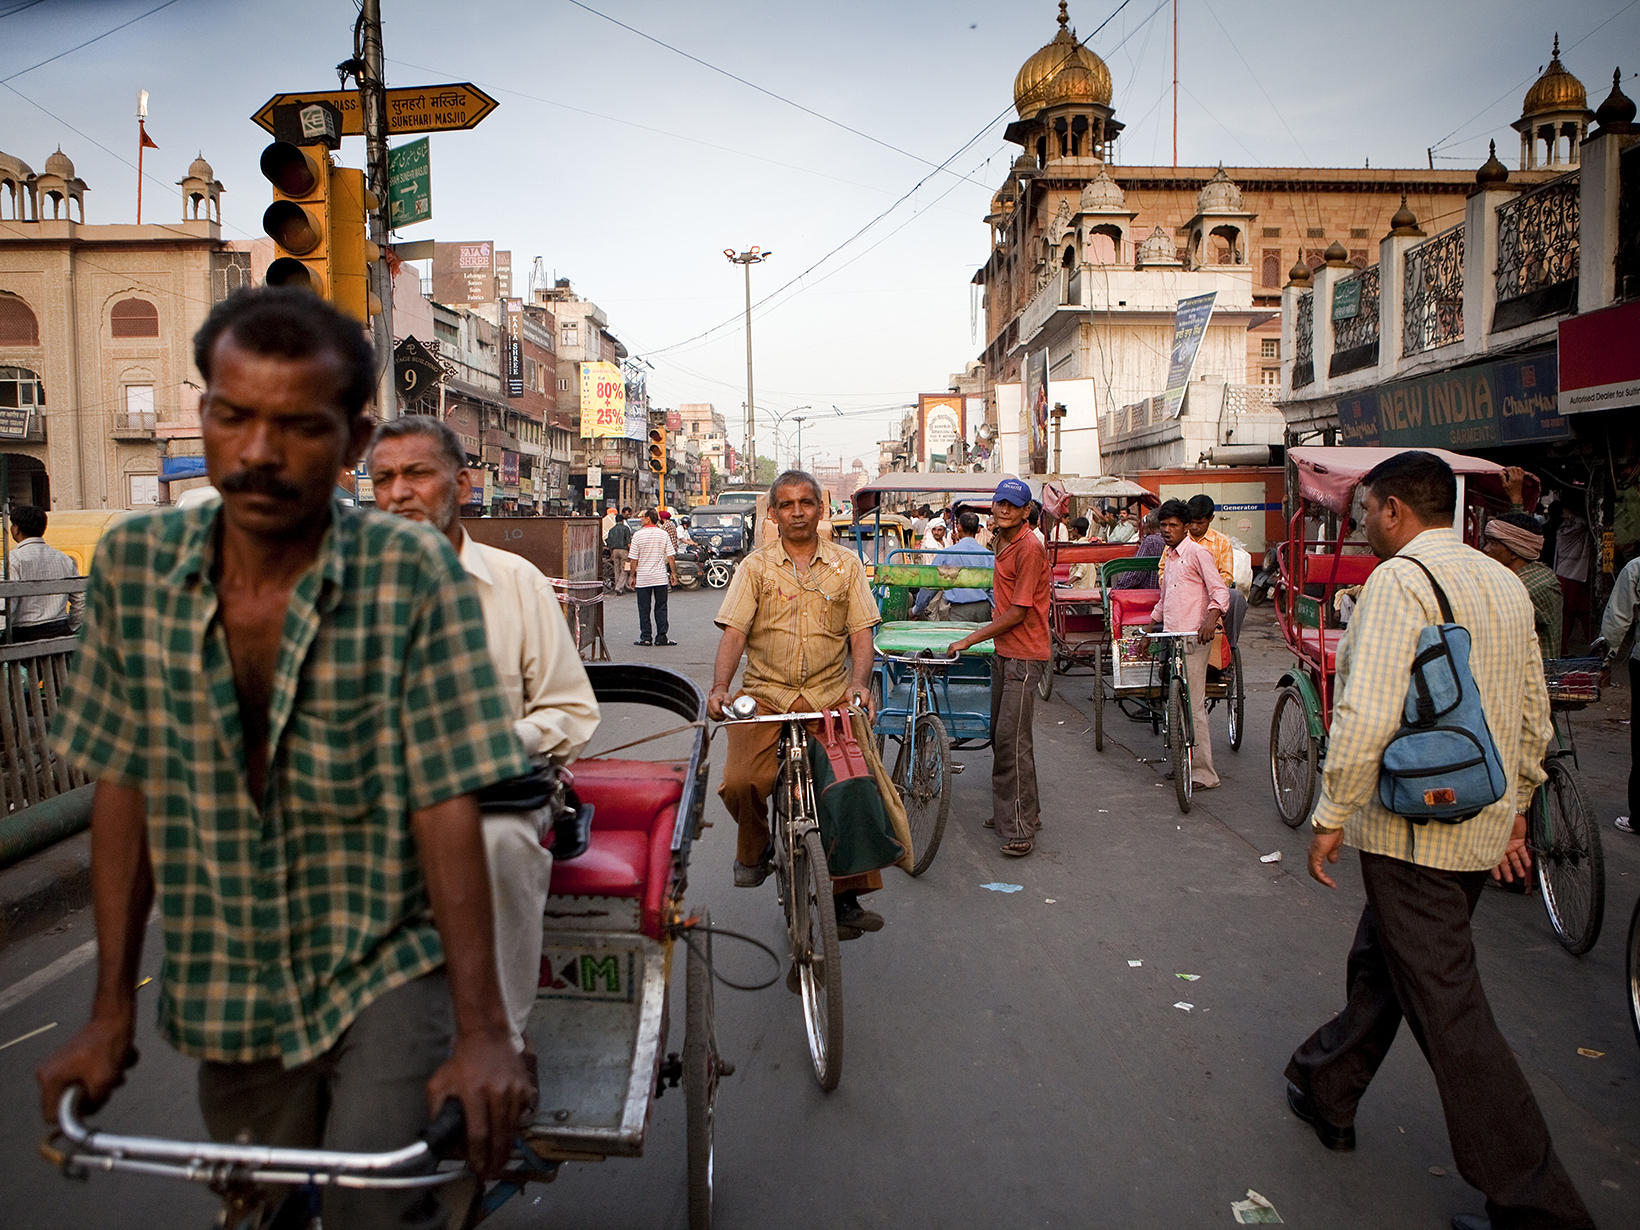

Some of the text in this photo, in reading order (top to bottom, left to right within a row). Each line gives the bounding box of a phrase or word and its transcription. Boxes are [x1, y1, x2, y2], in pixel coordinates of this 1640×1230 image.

[391, 95, 426, 115] सुनहरी
[391, 111, 466, 128] SUNEHARI MASJID
[459, 256, 489, 266] SHREE
[411, 356, 439, 373] BUILDING
[405, 368, 417, 391] 9
[596, 382, 624, 399] 80%
[1569, 393, 1595, 405] Autorised
[1595, 390, 1615, 401] Dealer
[1616, 389, 1624, 398] for
[1379, 373, 1494, 431] NEW INDIA
[596, 408, 624, 426] 25%
[1450, 425, 1496, 444] GARMENTS
